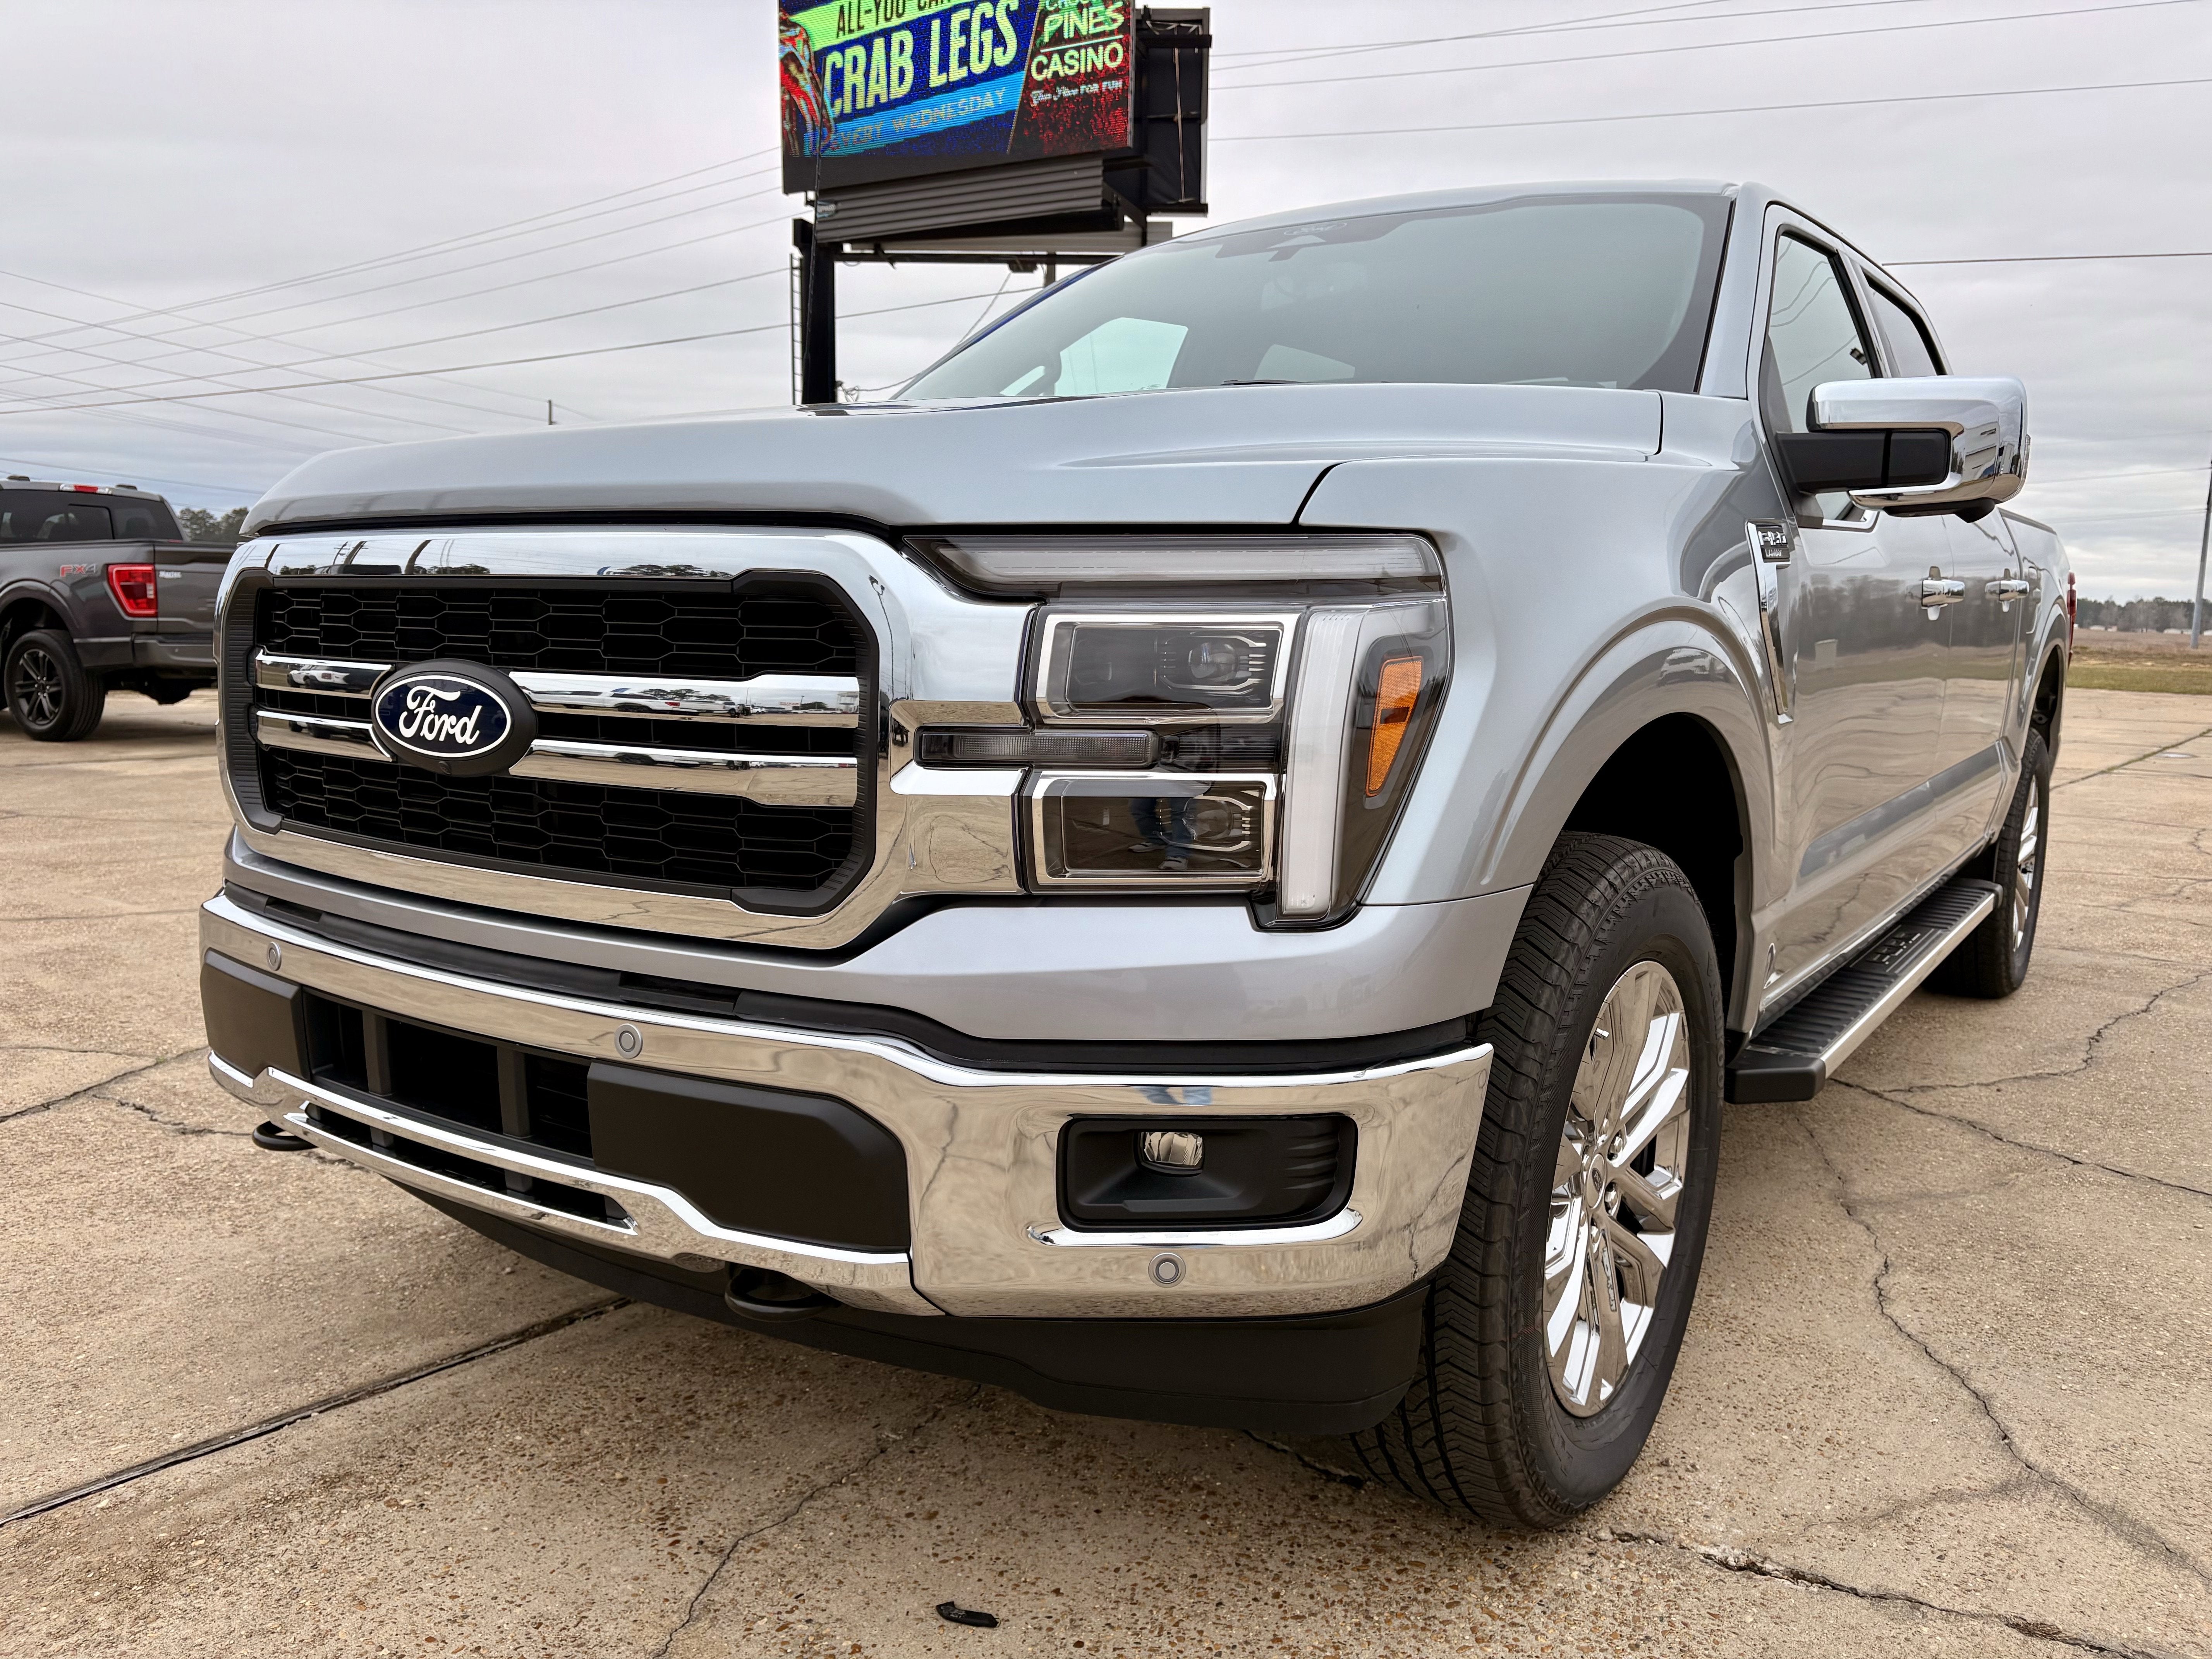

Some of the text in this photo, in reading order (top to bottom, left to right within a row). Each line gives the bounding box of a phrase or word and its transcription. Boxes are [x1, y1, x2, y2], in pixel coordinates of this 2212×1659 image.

[1043, 1, 1124, 43] PINES
[824, 0, 1019, 118] CRAB LEGS
[1031, 42, 1124, 81] CASINO
[892, 87, 1006, 133] WEDNESDAY
[60, 564, 97, 577] FX4
[398, 685, 483, 745] Ford
